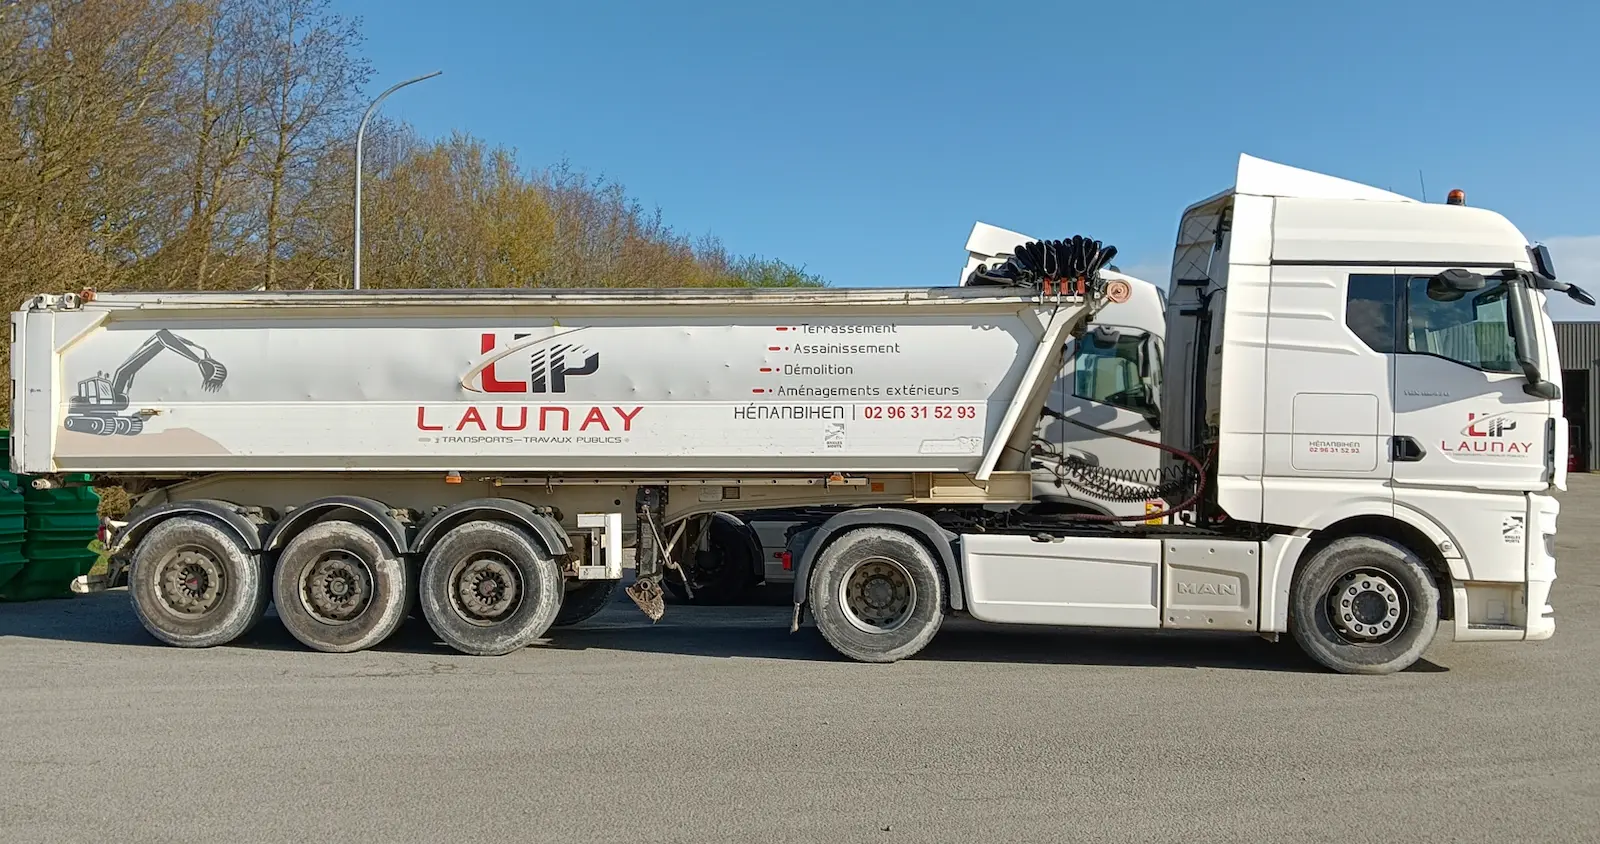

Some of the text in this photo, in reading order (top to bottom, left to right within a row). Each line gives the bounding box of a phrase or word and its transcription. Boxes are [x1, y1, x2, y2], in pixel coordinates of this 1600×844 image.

[802, 323, 898, 334] Terrassement
[793, 343, 900, 355] Assainissement
[784, 363, 853, 376] Démolition
[778, 384, 960, 399] Aménagements extérieurs
[734, 402, 976, 420] HÉNANBIHEN 02 96 31 52 93
[417, 406, 644, 431] LAUNAY
[576, 436, 622, 444] PUBLICS
[1441, 440, 1533, 453] LAUNAY
[1177, 582, 1237, 596] MAN
